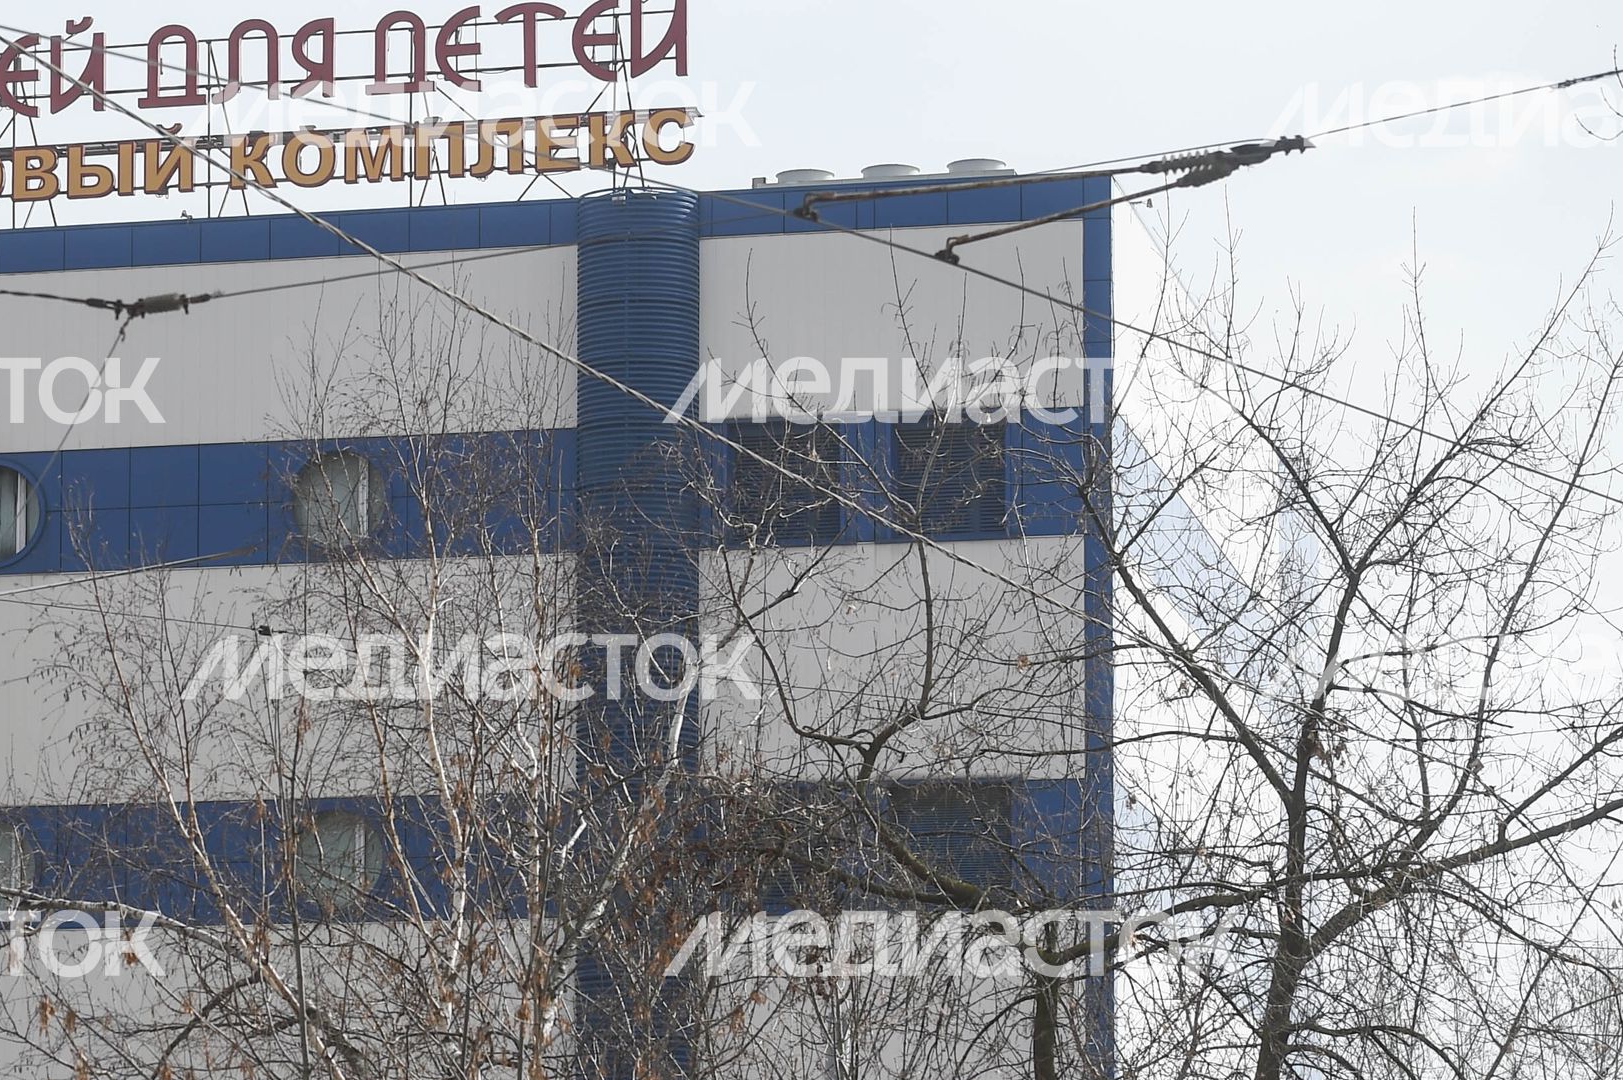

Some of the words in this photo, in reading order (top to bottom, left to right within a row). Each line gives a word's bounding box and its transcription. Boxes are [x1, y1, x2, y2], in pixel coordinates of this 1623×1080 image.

[137, 24, 336, 109] ДЛЯ
[365, 0, 690, 95] ДЕТЕЙ
[230, 109, 698, 190] КОМПЛЕКС
